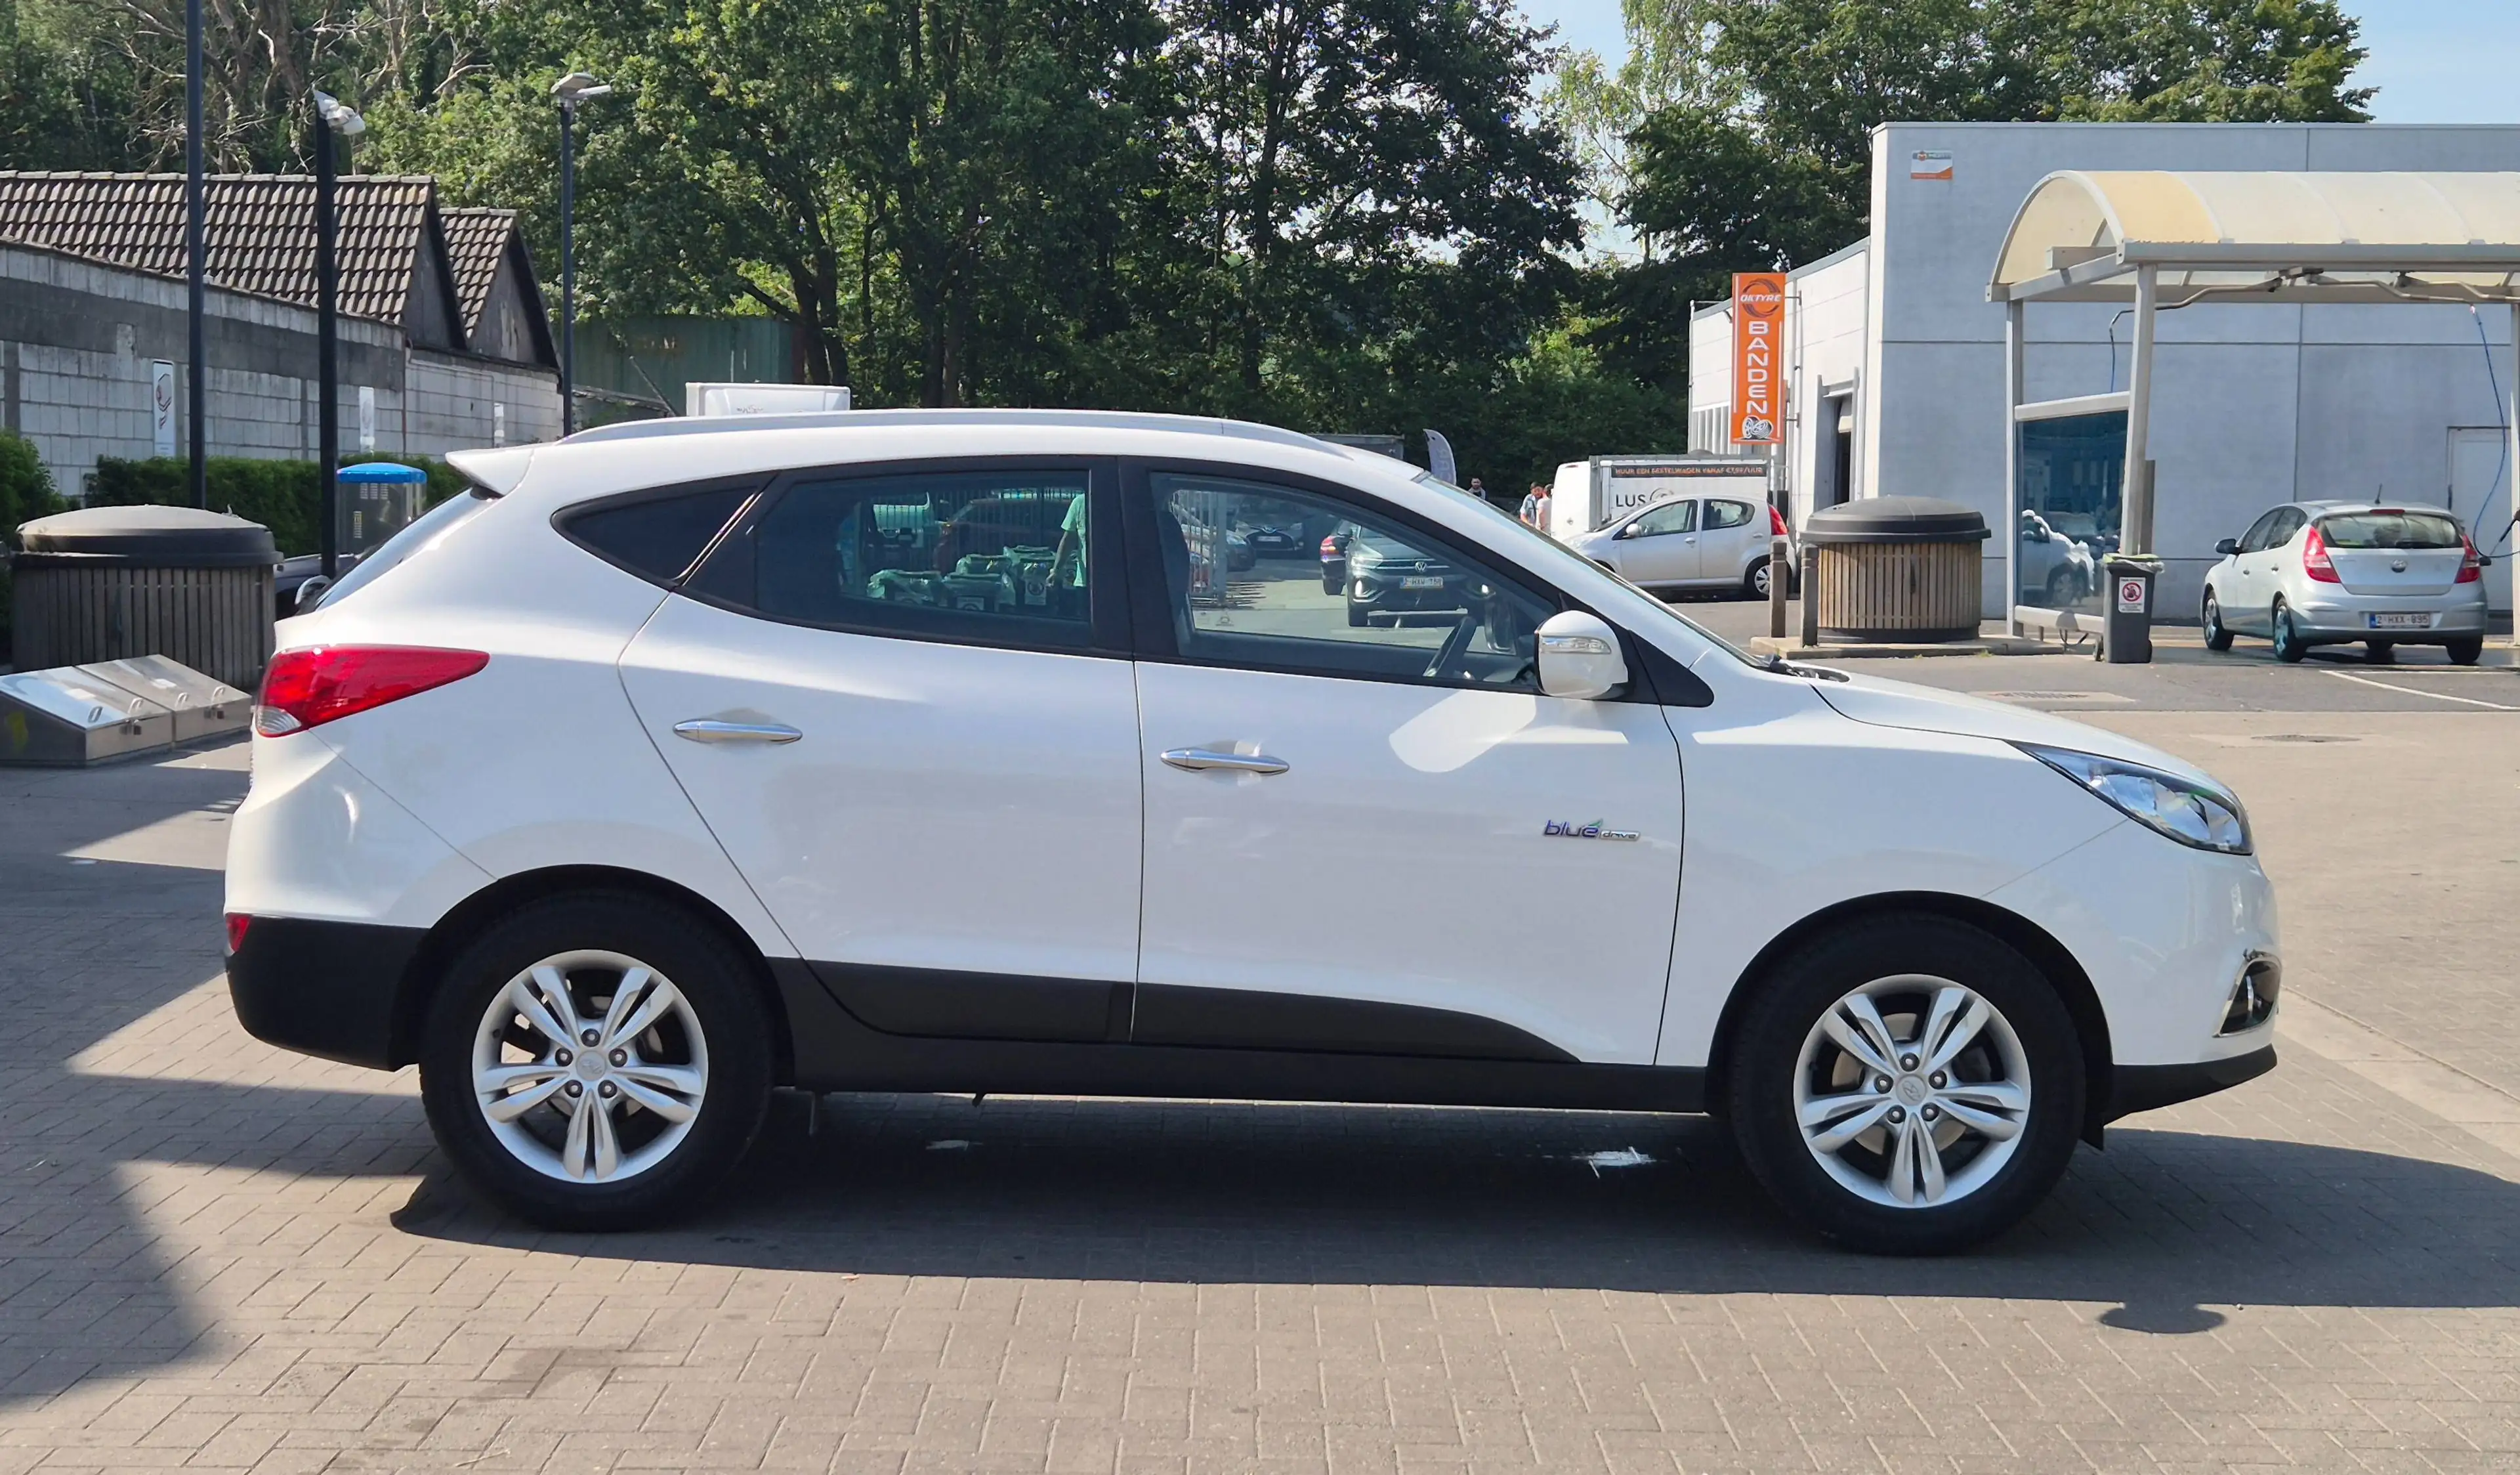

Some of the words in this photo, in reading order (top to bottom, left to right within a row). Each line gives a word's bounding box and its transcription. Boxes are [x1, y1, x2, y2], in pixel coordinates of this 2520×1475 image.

[1746, 320, 1769, 414] BANDEN
[1544, 820, 1599, 838] blue
[1603, 830, 1636, 840] drive
